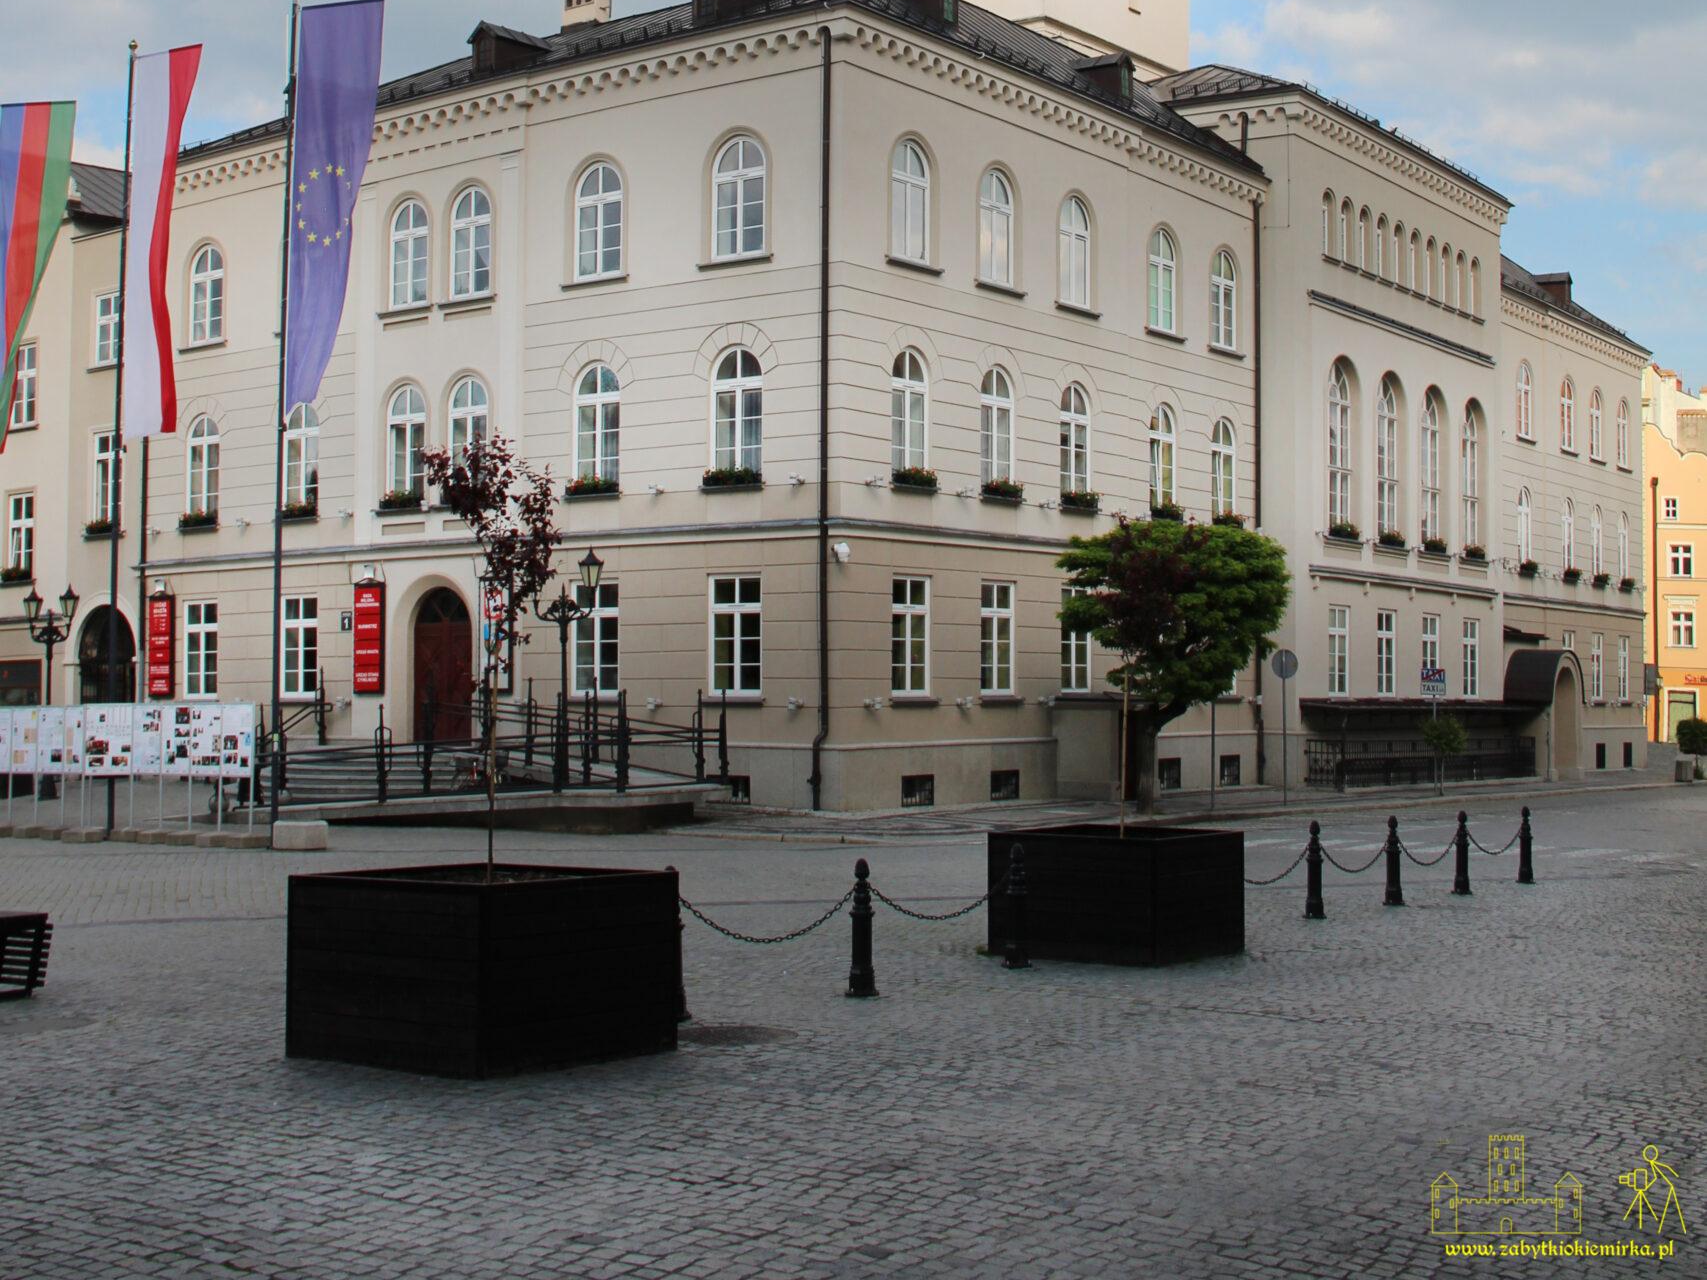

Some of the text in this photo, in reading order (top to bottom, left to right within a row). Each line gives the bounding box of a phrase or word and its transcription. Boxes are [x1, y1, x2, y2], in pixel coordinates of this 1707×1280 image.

[343, 617, 349, 629] 1
[1422, 670, 1444, 681] TAXI
[1422, 683, 1439, 692] TAXI
